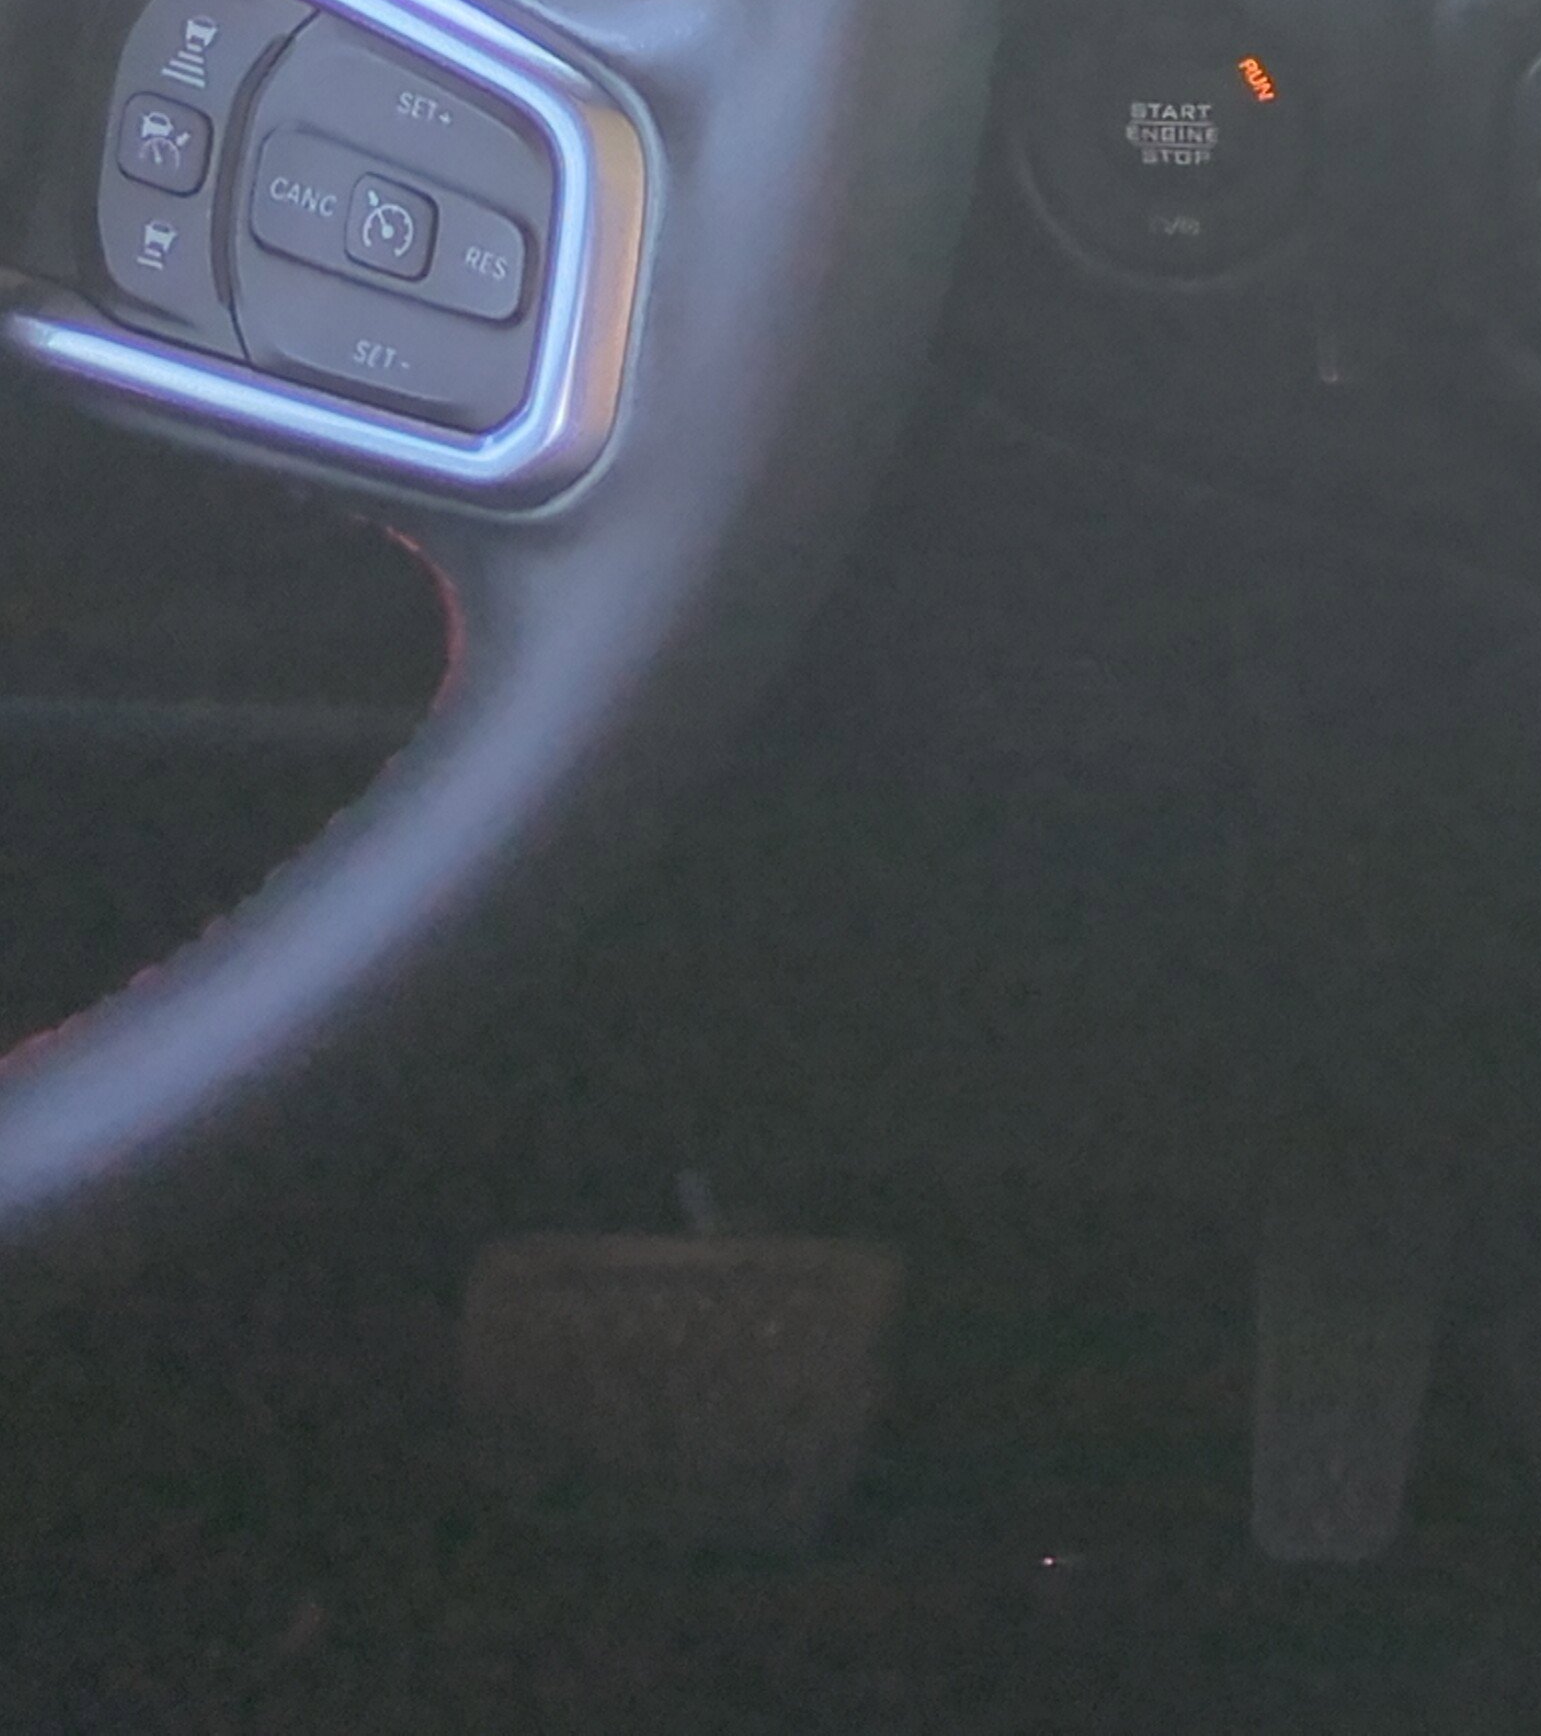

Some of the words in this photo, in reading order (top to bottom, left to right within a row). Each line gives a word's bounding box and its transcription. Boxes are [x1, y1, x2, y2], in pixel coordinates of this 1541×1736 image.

[1238, 58, 1275, 102] RUN
[1130, 101, 1211, 120] START
[1125, 125, 1218, 144] ENGINE
[1142, 149, 1210, 165] STOP
[269, 177, 337, 217] CANC
[466, 245, 508, 278] RES
